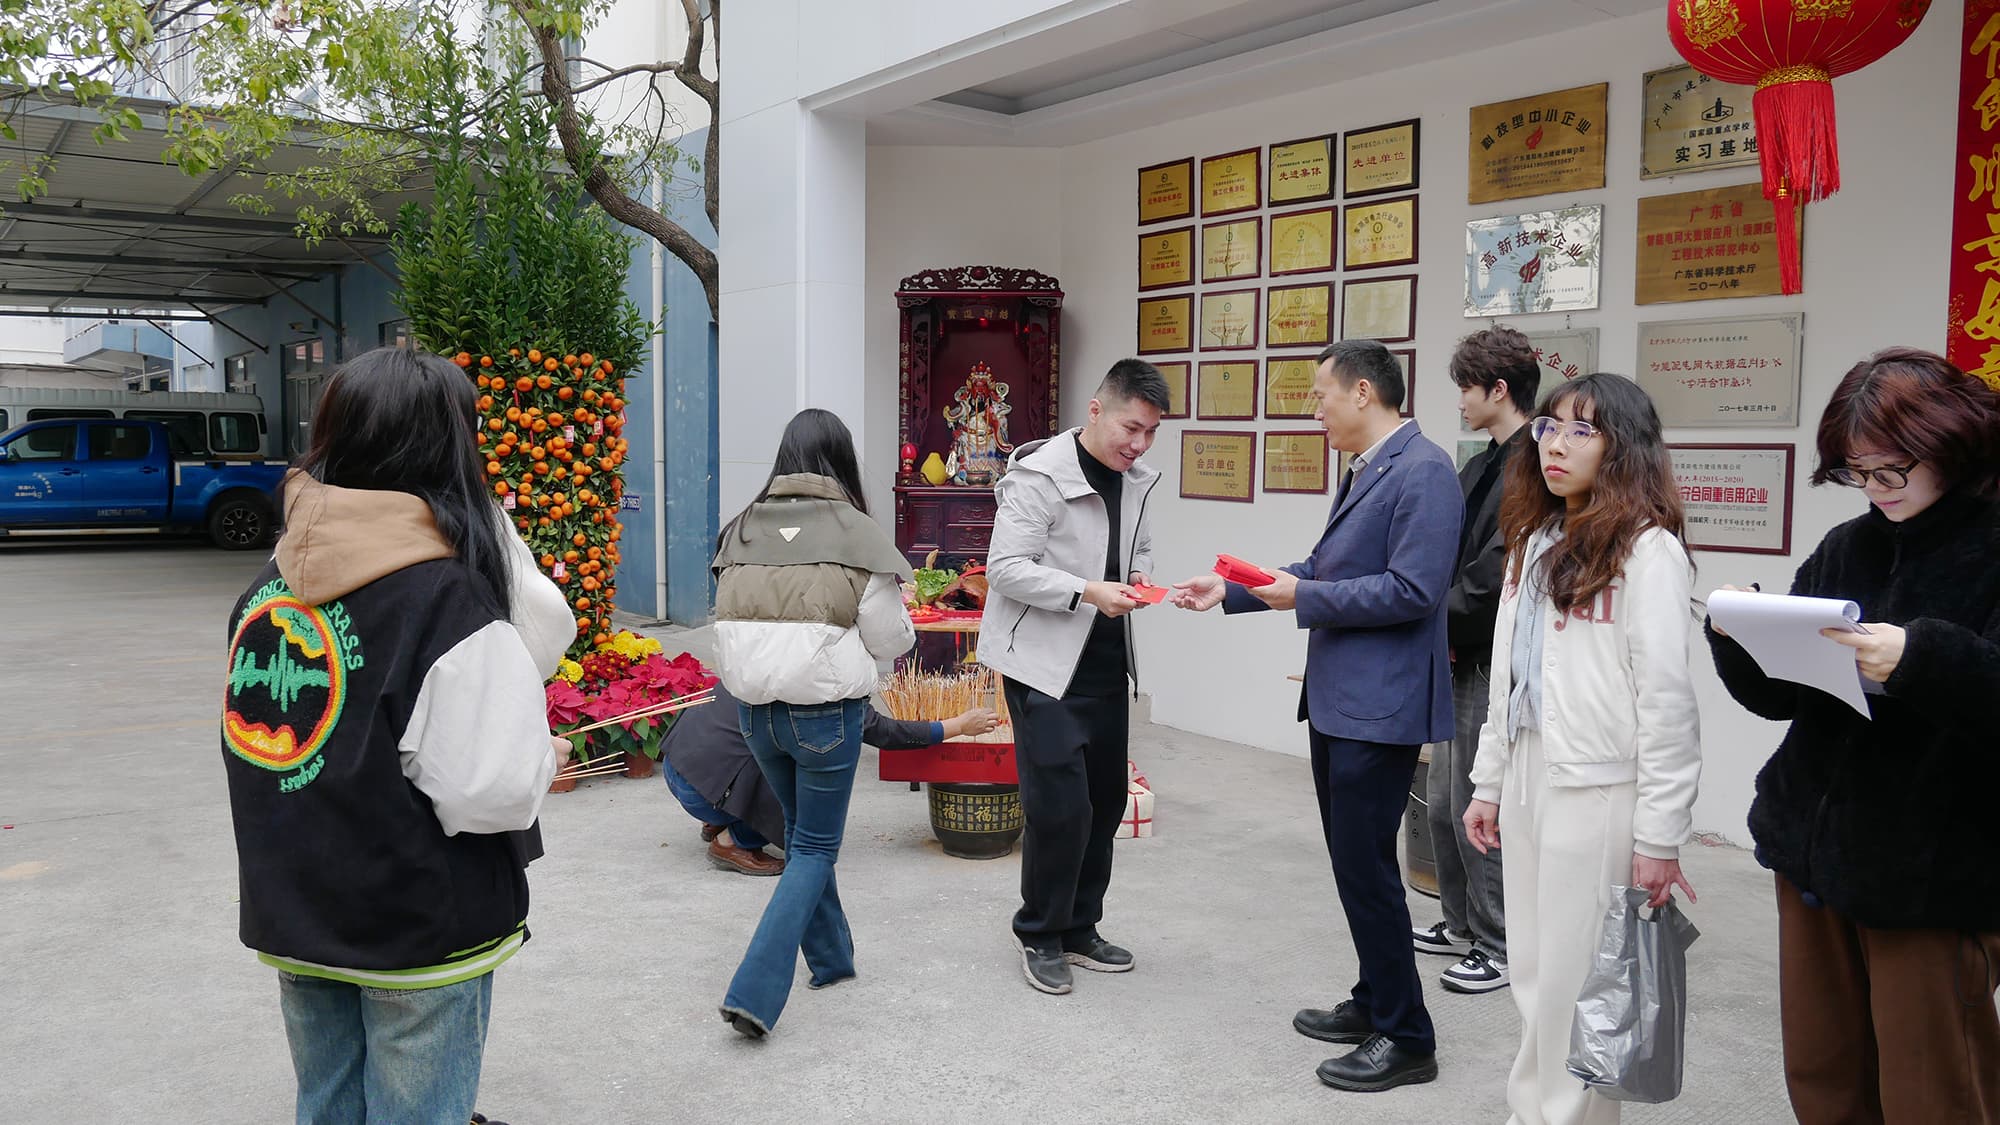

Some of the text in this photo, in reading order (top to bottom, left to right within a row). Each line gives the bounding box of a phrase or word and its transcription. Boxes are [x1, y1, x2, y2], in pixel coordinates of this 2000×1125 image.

[1480, 108, 1592, 151] 科技型中小企业
[1675, 137, 1759, 163] 实习基地
[1352, 151, 1407, 169] 先进单位
[1278, 166, 1322, 181] 先进集体
[1689, 201, 1745, 223] 广东省
[1480, 229, 1584, 270] 高新技术企业
[1671, 242, 1761, 261] 工程技术研究中心
[1674, 263, 1757, 280] 广东省科学技术厅
[1196, 458, 1236, 471] 会员单位
[1680, 486, 1769, 504] 守合同重信用企业
[942, 803, 957, 821] 福
[974, 805, 993, 823] 福
